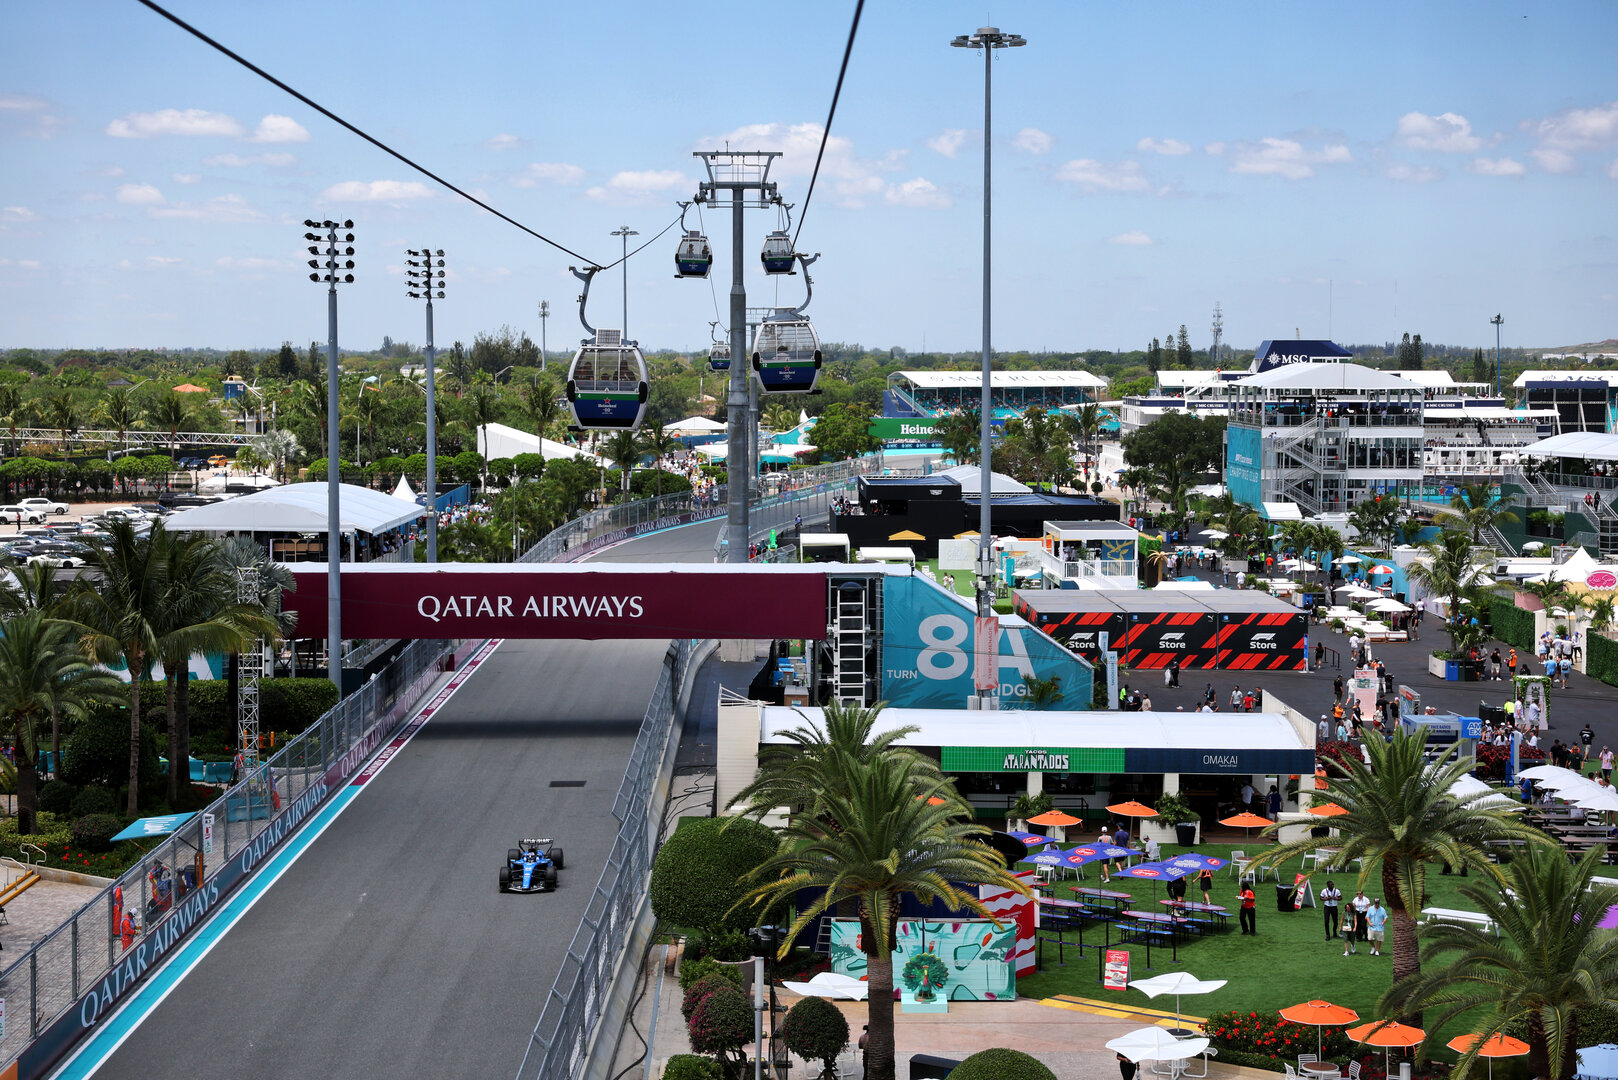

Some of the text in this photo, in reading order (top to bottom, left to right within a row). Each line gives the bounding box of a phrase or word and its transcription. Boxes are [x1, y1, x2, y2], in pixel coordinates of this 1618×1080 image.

[1281, 354, 1308, 364] MSC
[417, 595, 644, 622] QATAR AIRWAYS
[1069, 641, 1096, 649] Store
[1159, 641, 1186, 649] Store
[1250, 641, 1277, 649] Store
[886, 669, 918, 679] TURN
[341, 738, 369, 778] QATAR
[1003, 754, 1069, 770] ATARANTADOS
[1203, 755, 1238, 765] OMAKAI
[242, 776, 327, 873] QATAR AIRWAYS
[81, 881, 219, 1028] QATAR AIRWAYS
